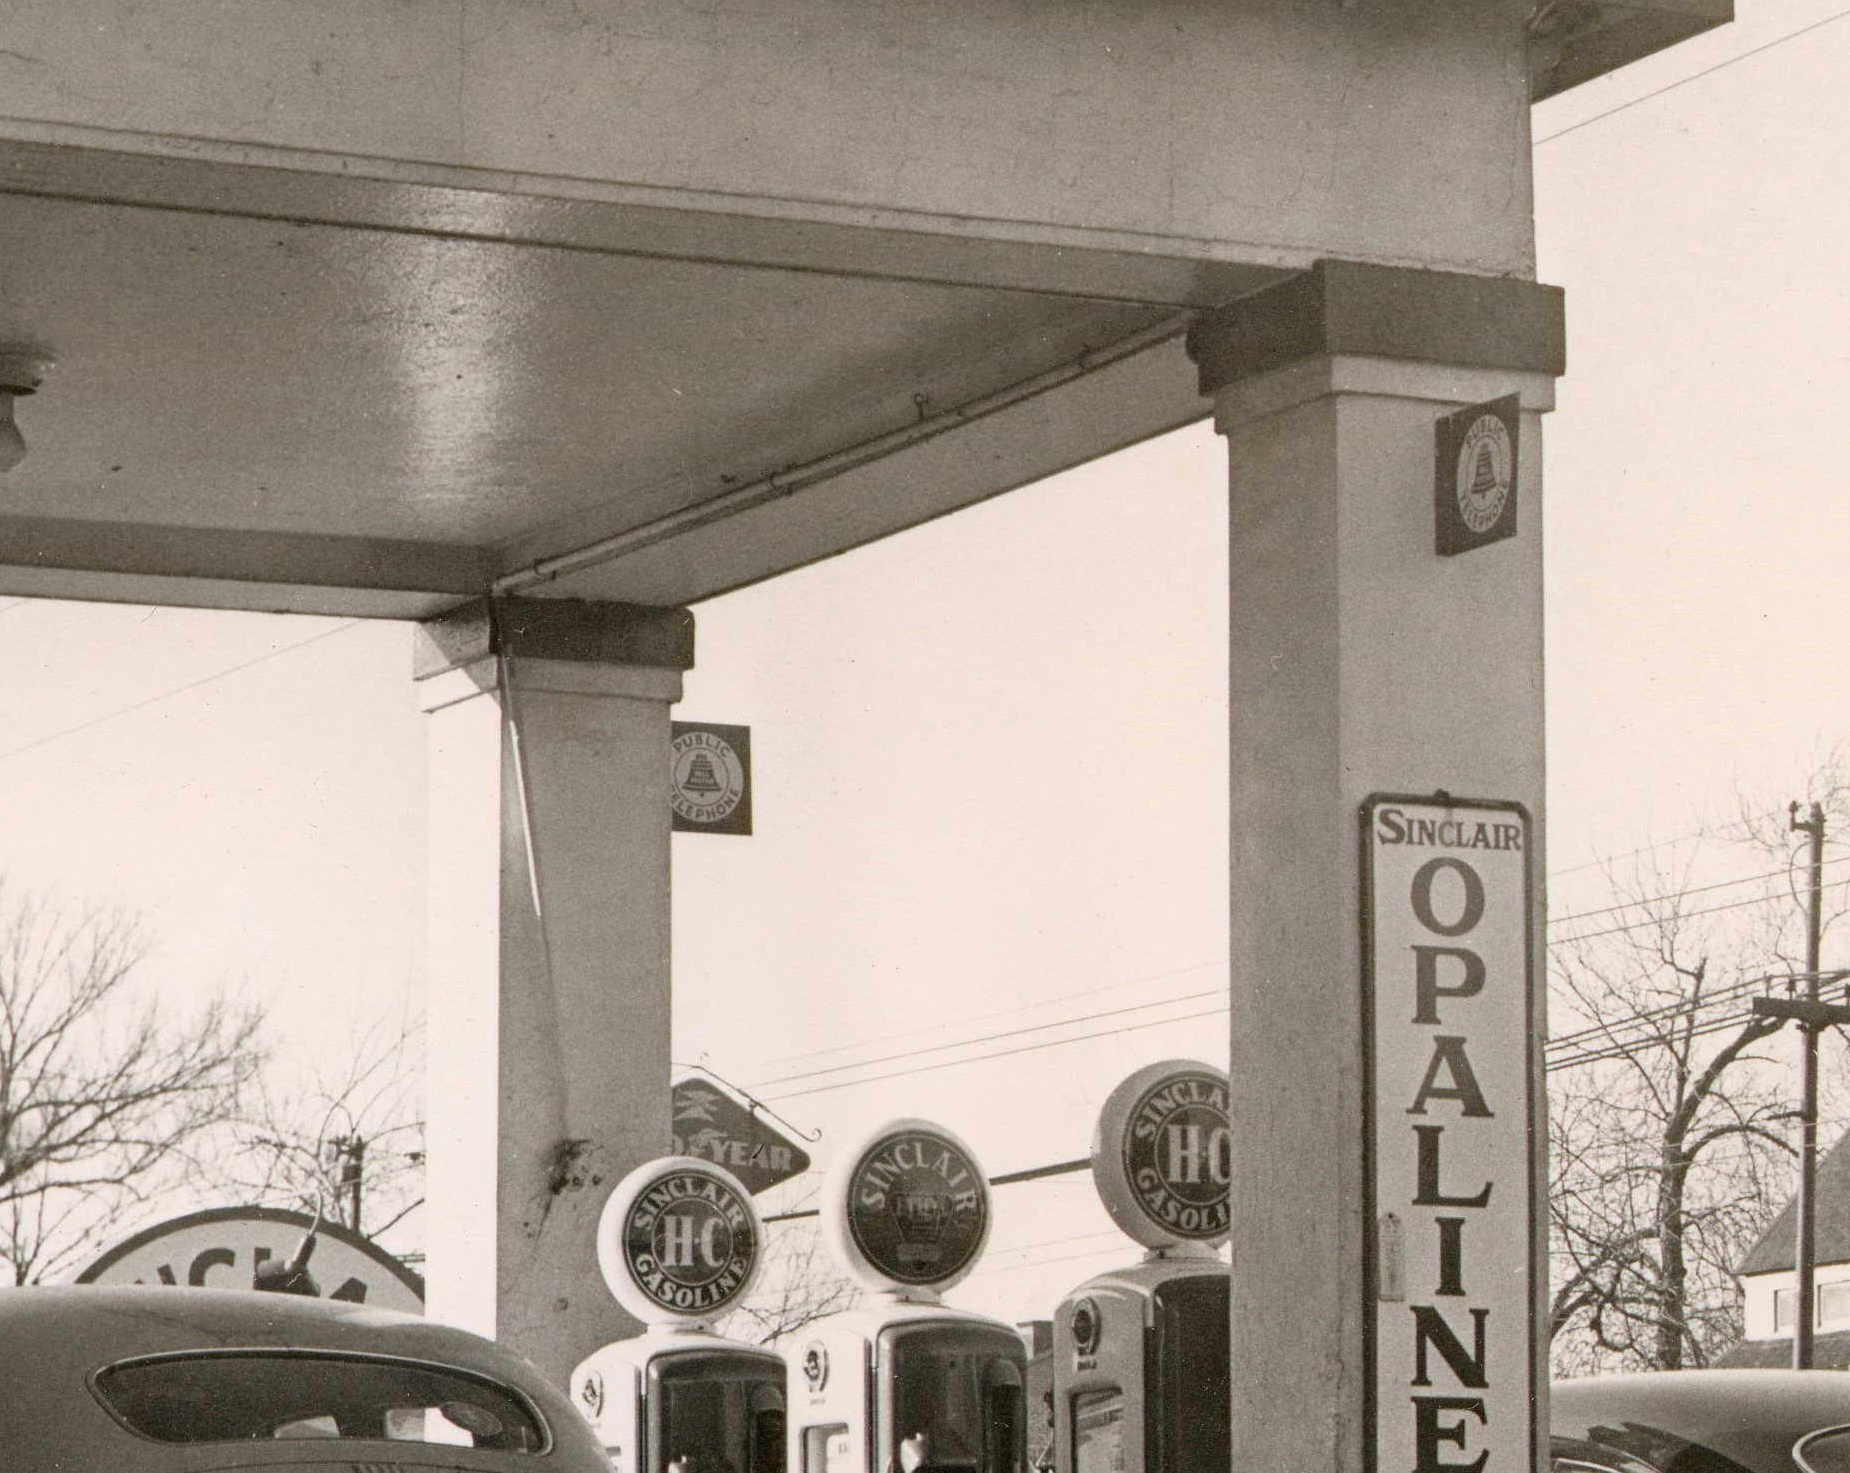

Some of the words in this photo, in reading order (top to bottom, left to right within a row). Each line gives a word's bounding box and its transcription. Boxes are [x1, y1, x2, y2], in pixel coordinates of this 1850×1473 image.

[1465, 415, 1504, 449] PUBLIC
[673, 733, 732, 758] PUBLIC
[1376, 807, 1523, 851] SINCLAIR
[861, 1140, 977, 1213] SINCLAIR
[634, 1177, 746, 1230] SINCLAIR
[635, 1253, 748, 1308] GASOLINE
